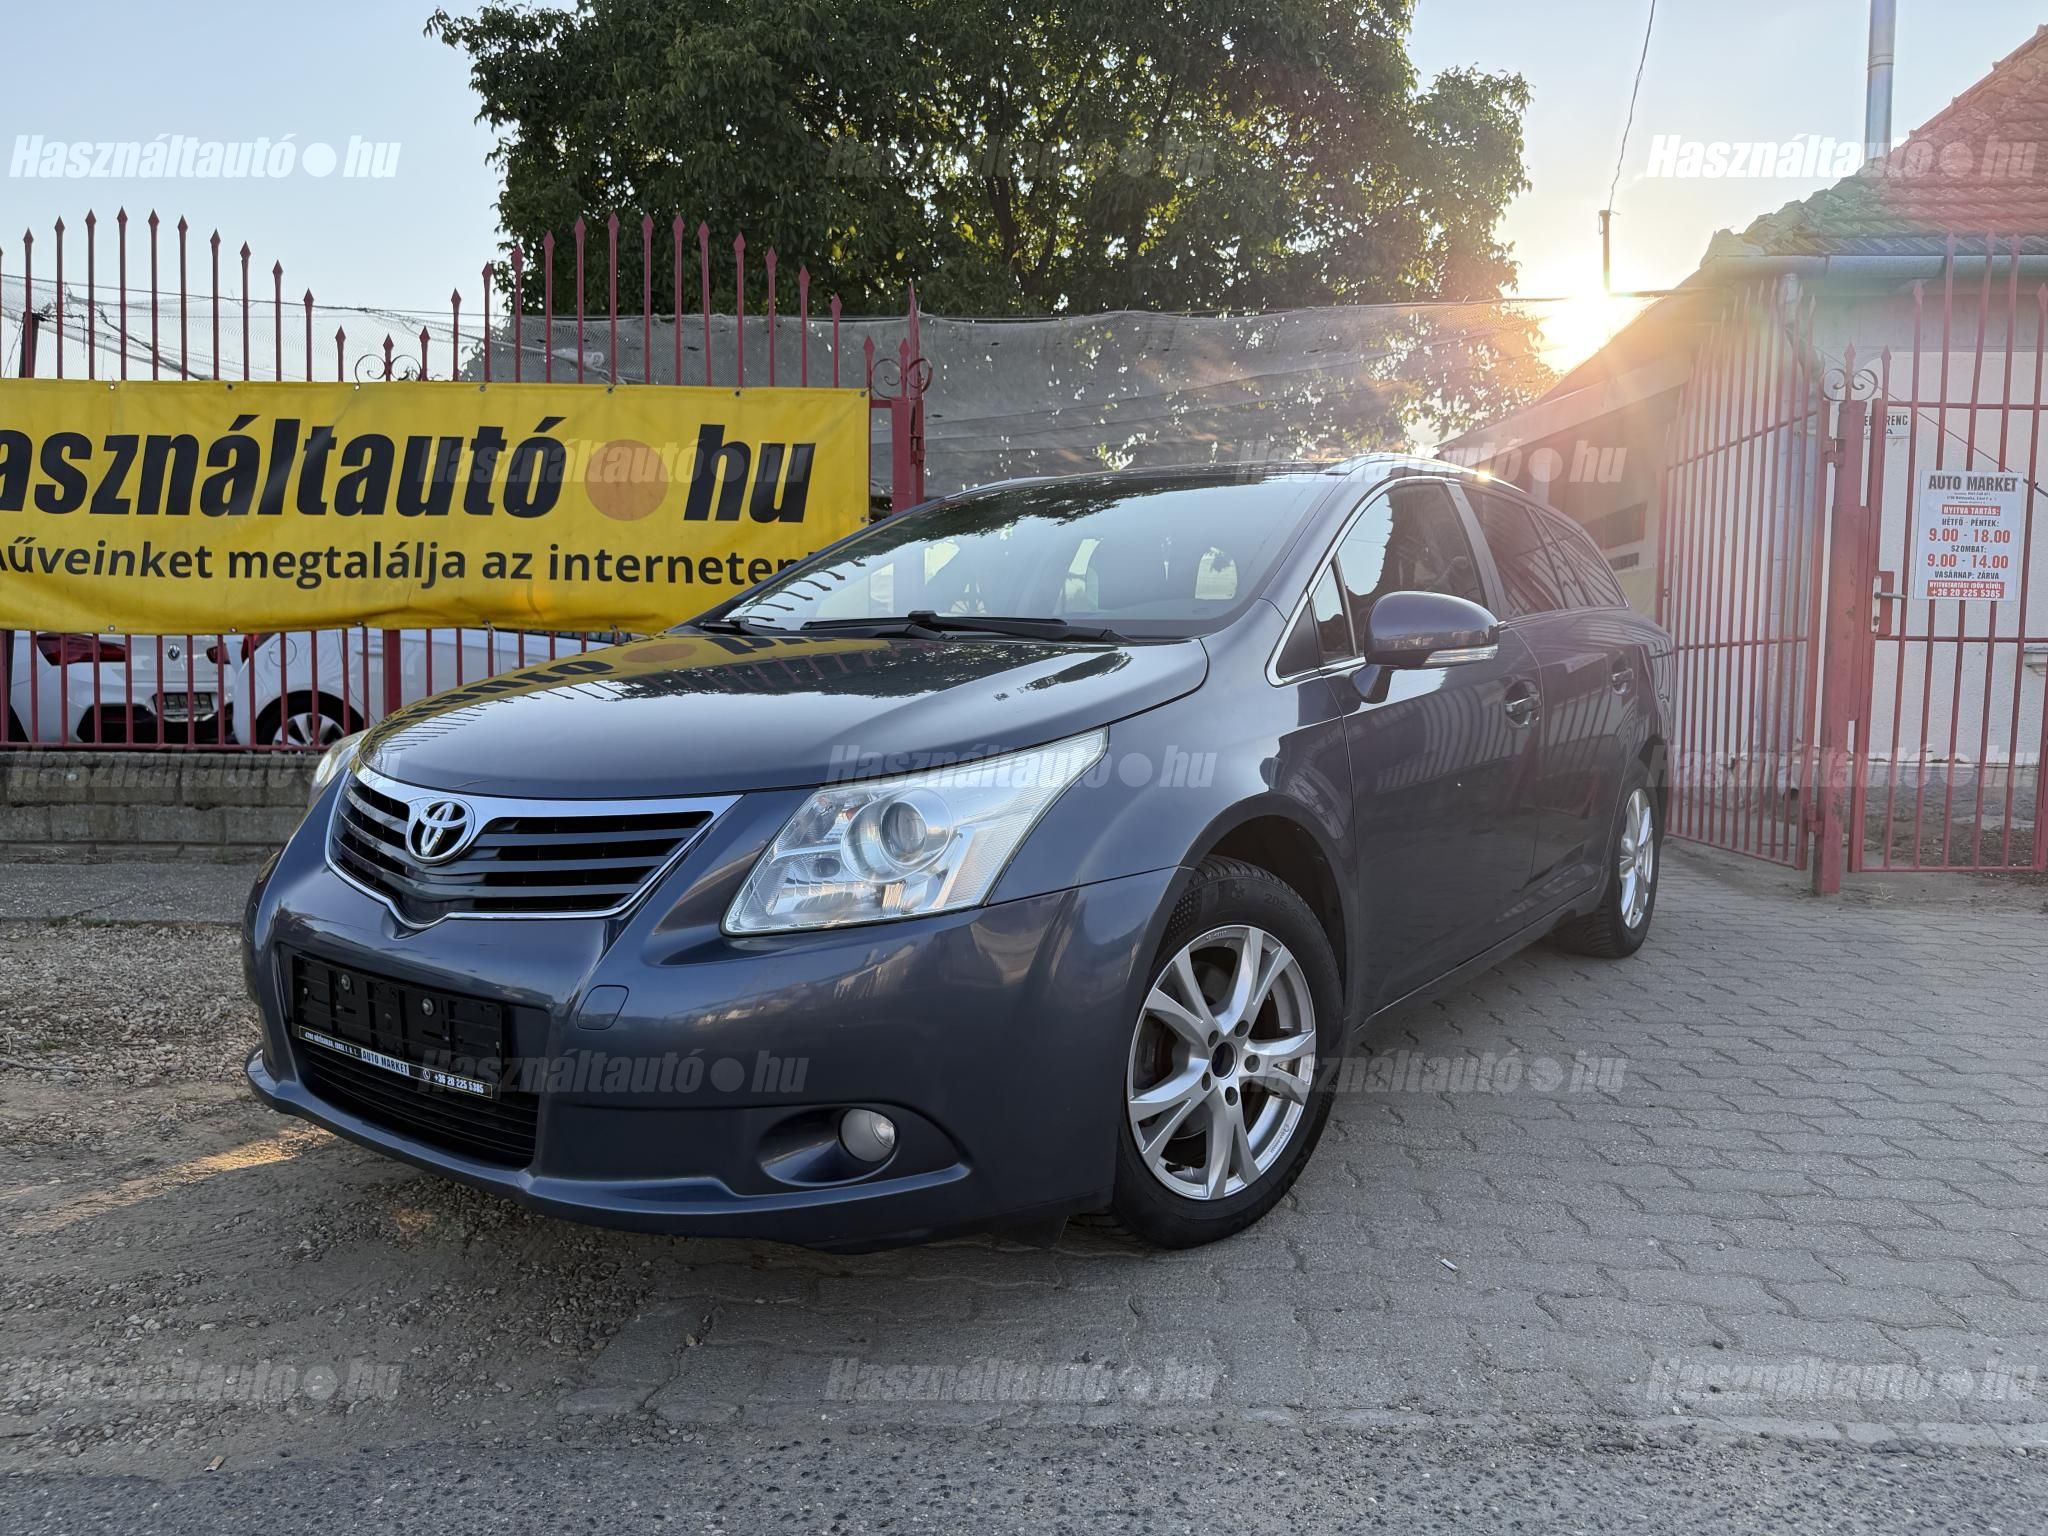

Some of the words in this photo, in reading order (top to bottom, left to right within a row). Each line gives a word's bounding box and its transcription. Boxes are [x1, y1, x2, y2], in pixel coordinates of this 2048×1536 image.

[1928, 475, 1961, 490] AUTO
[1967, 476, 2017, 492] MARKET
[1943, 506, 1968, 515] NYITVA
[1942, 517, 1963, 526] HÉTFŐ
[1971, 517, 2000, 528] PÉNTEK:
[1929, 528, 1959, 542] 9.00
[1974, 529, 2011, 543] 18.00
[1951, 545, 1987, 553] SZOMBAT:
[0, 536, 213, 579] űveinket
[228, 541, 466, 590] megtalálja
[482, 551, 532, 580] az
[550, 544, 816, 585] internete
[1927, 553, 1957, 567] 9.00
[1972, 554, 2009, 569] 14.00
[1934, 570, 1975, 579] VASÁRNAP:
[1977, 571, 1999, 580] ZÁRVA
[1930, 588, 1948, 597] +36
[1950, 588, 1960, 597] 20
[1962, 589, 1978, 597] 225
[362, 1050, 379, 1064] AUTO
[381, 1055, 408, 1073] MARKET
